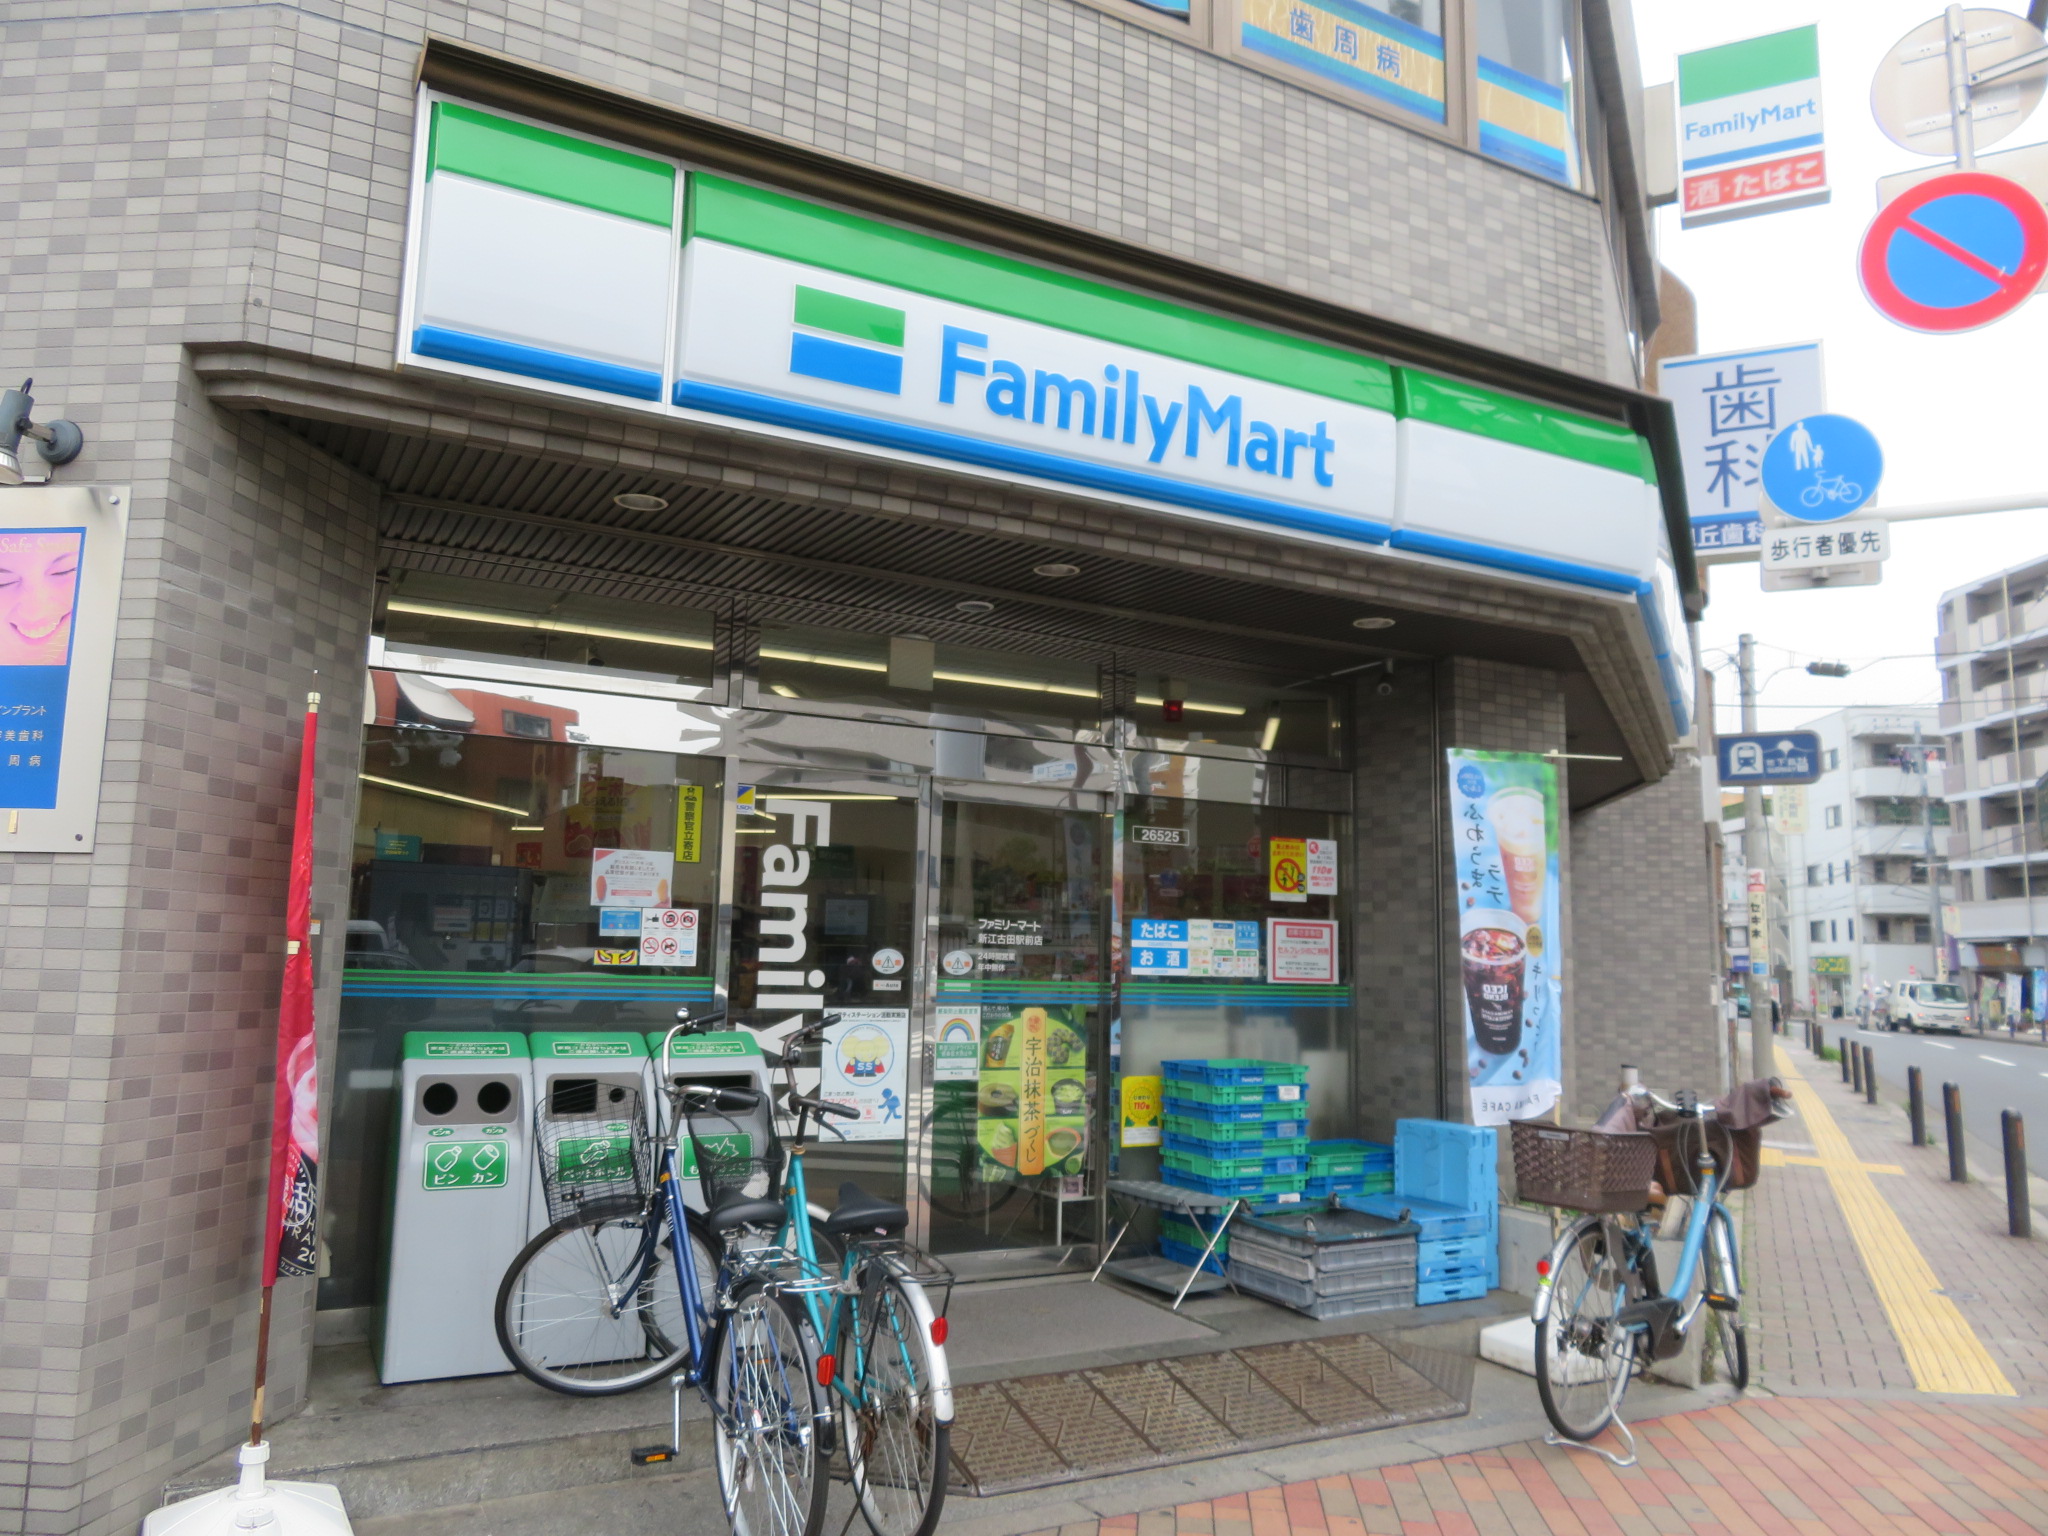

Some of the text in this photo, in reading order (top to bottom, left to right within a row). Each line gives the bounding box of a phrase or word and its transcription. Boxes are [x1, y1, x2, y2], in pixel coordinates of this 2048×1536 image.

[1290, 8, 1400, 79] 歯周病
[1685, 97, 1817, 141] FamilyMart
[1689, 159, 1822, 207] 酒・たばこ
[938, 324, 1335, 488] FamilyMart
[1690, 520, 1767, 549] 丘歯科
[1771, 531, 1880, 561] 歩行者優先
[0, 705, 47, 716] ンプラント
[683, 802, 696, 860] 警察官立寄店
[1141, 829, 1180, 843] 26525
[978, 919, 1041, 932] ファミリーマート
[1141, 922, 1180, 939] たばこ
[977, 933, 1043, 946] 新江古田駅前店
[978, 952, 1015, 961] 24時間営業
[1140, 950, 1180, 967] お酒
[978, 963, 1006, 971] 年中無休
[857, 1062, 873, 1071] SS
[1024, 1037, 1042, 1163] 宇治抹茶づくし
[434, 1173, 460, 1185] ビン
[472, 1172, 498, 1184] カン
[563, 1166, 627, 1179] ペットボトル
